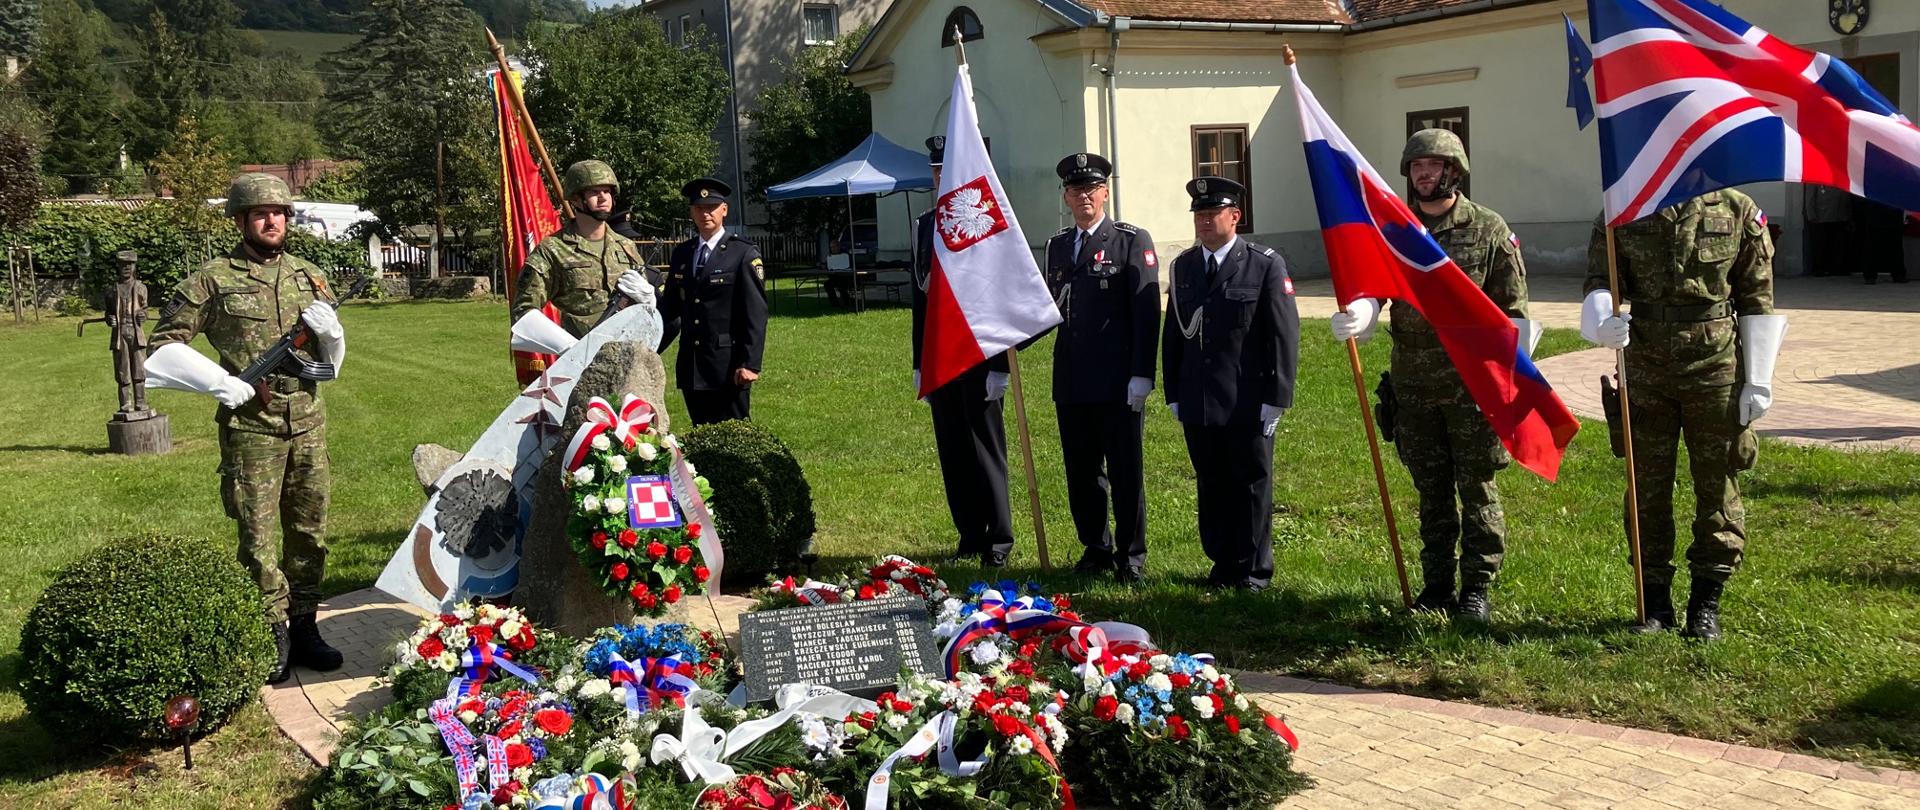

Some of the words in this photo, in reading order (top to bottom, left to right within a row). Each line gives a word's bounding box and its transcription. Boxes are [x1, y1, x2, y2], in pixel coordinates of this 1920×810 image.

[790, 624, 812, 634] URAM
[792, 630, 837, 641] KRYSZCZUK
[841, 623, 888, 634] FRANCISZEK
[895, 621, 911, 629] 1911
[835, 633, 869, 643] TADEUSZ
[794, 643, 848, 656] KRZECZEWSKI
[852, 638, 894, 648] EUGENIUSZ
[796, 654, 822, 663] MAJER
[826, 650, 856, 660] TEODOR
[858, 654, 884, 664] KAROL
[798, 670, 820, 678] LISIK
[835, 672, 866, 682] WIKTOR
